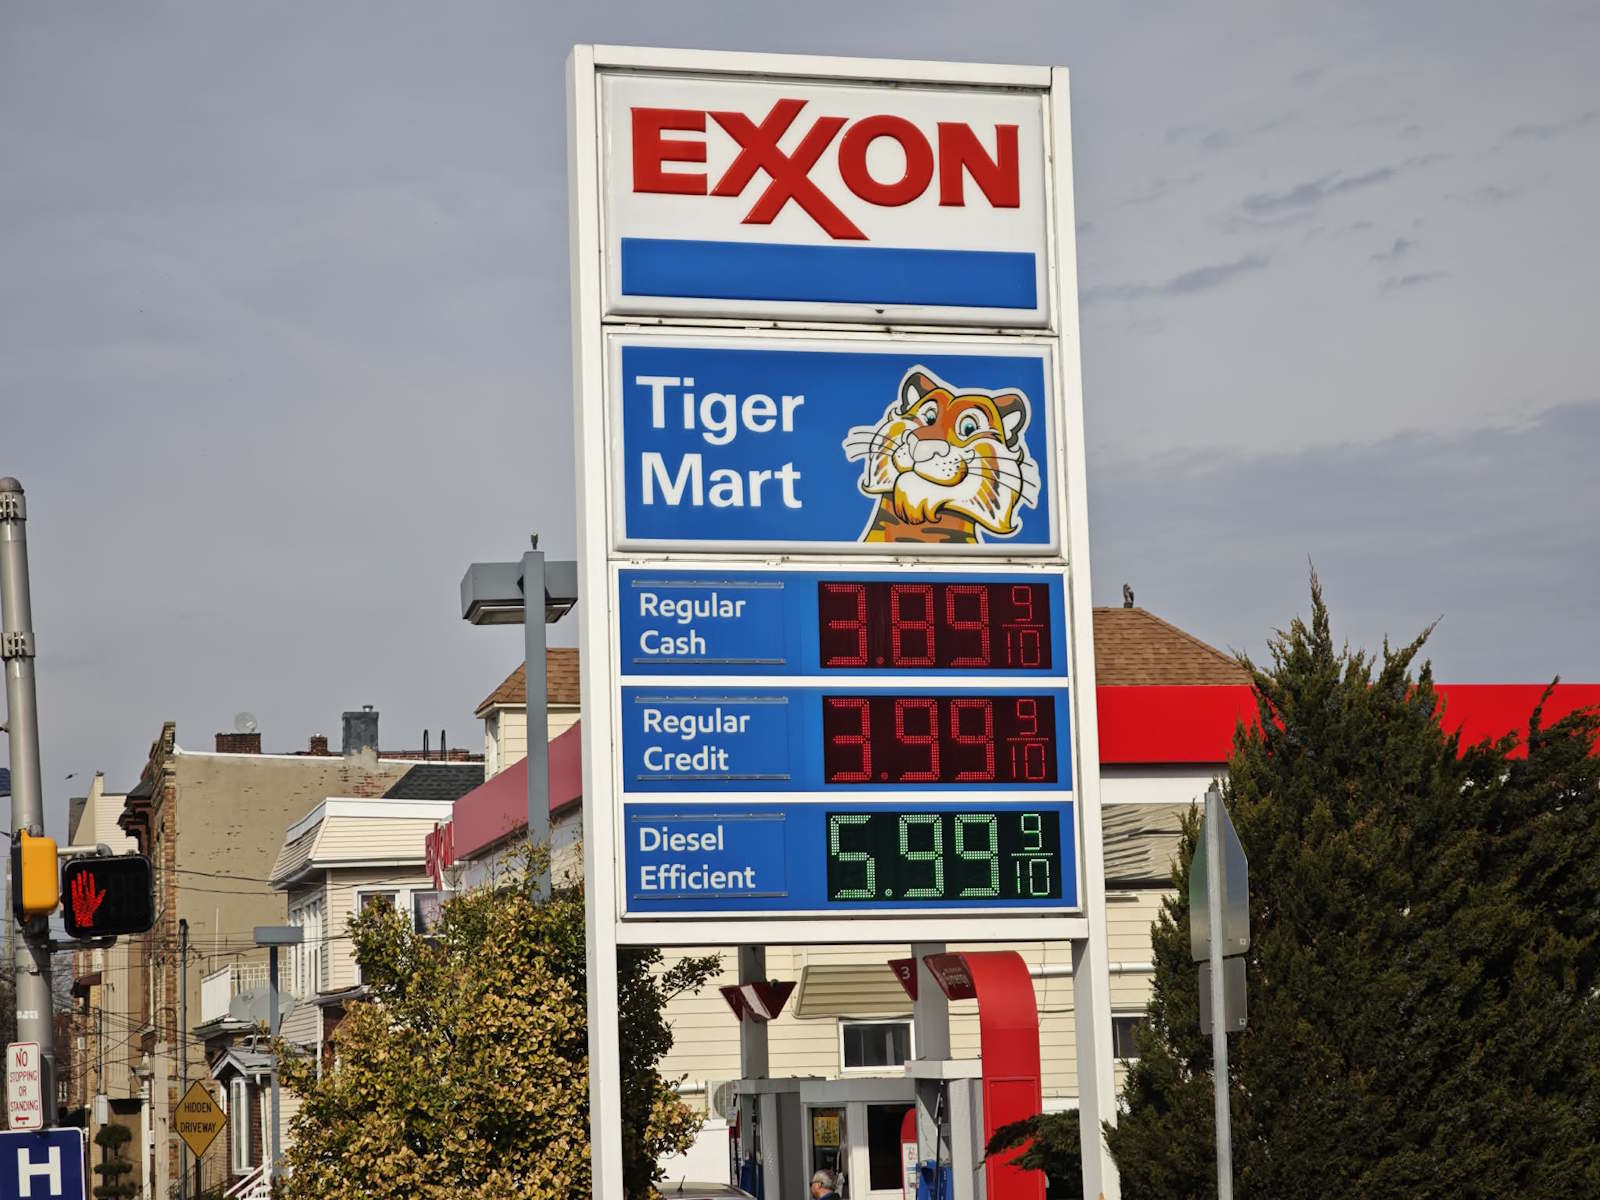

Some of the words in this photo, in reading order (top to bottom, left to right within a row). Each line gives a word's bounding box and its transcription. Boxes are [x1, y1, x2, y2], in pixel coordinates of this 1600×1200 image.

[630, 98, 1021, 241] EXXON
[635, 374, 805, 446] Tiger
[641, 451, 804, 509] Mart
[639, 592, 746, 625] Regular
[825, 584, 991, 666] 3.89
[639, 629, 706, 655] Cash
[643, 707, 750, 741] Regular
[828, 699, 996, 781] 3.99
[643, 745, 729, 771] Credit
[639, 825, 724, 852] Diesel
[830, 814, 1001, 898] 5.99
[640, 864, 756, 890] Efficient
[900, 966, 911, 980] 3
[15, 1051, 28, 1067] NO
[9, 1070, 38, 1083] STOPPING
[18, 1086, 27, 1096] OR
[9, 1100, 39, 1112] STANDING
[184, 1102, 212, 1113] HIDDEN
[180, 1122, 217, 1133] DRIVEWAY
[17, 1146, 62, 1197] H
